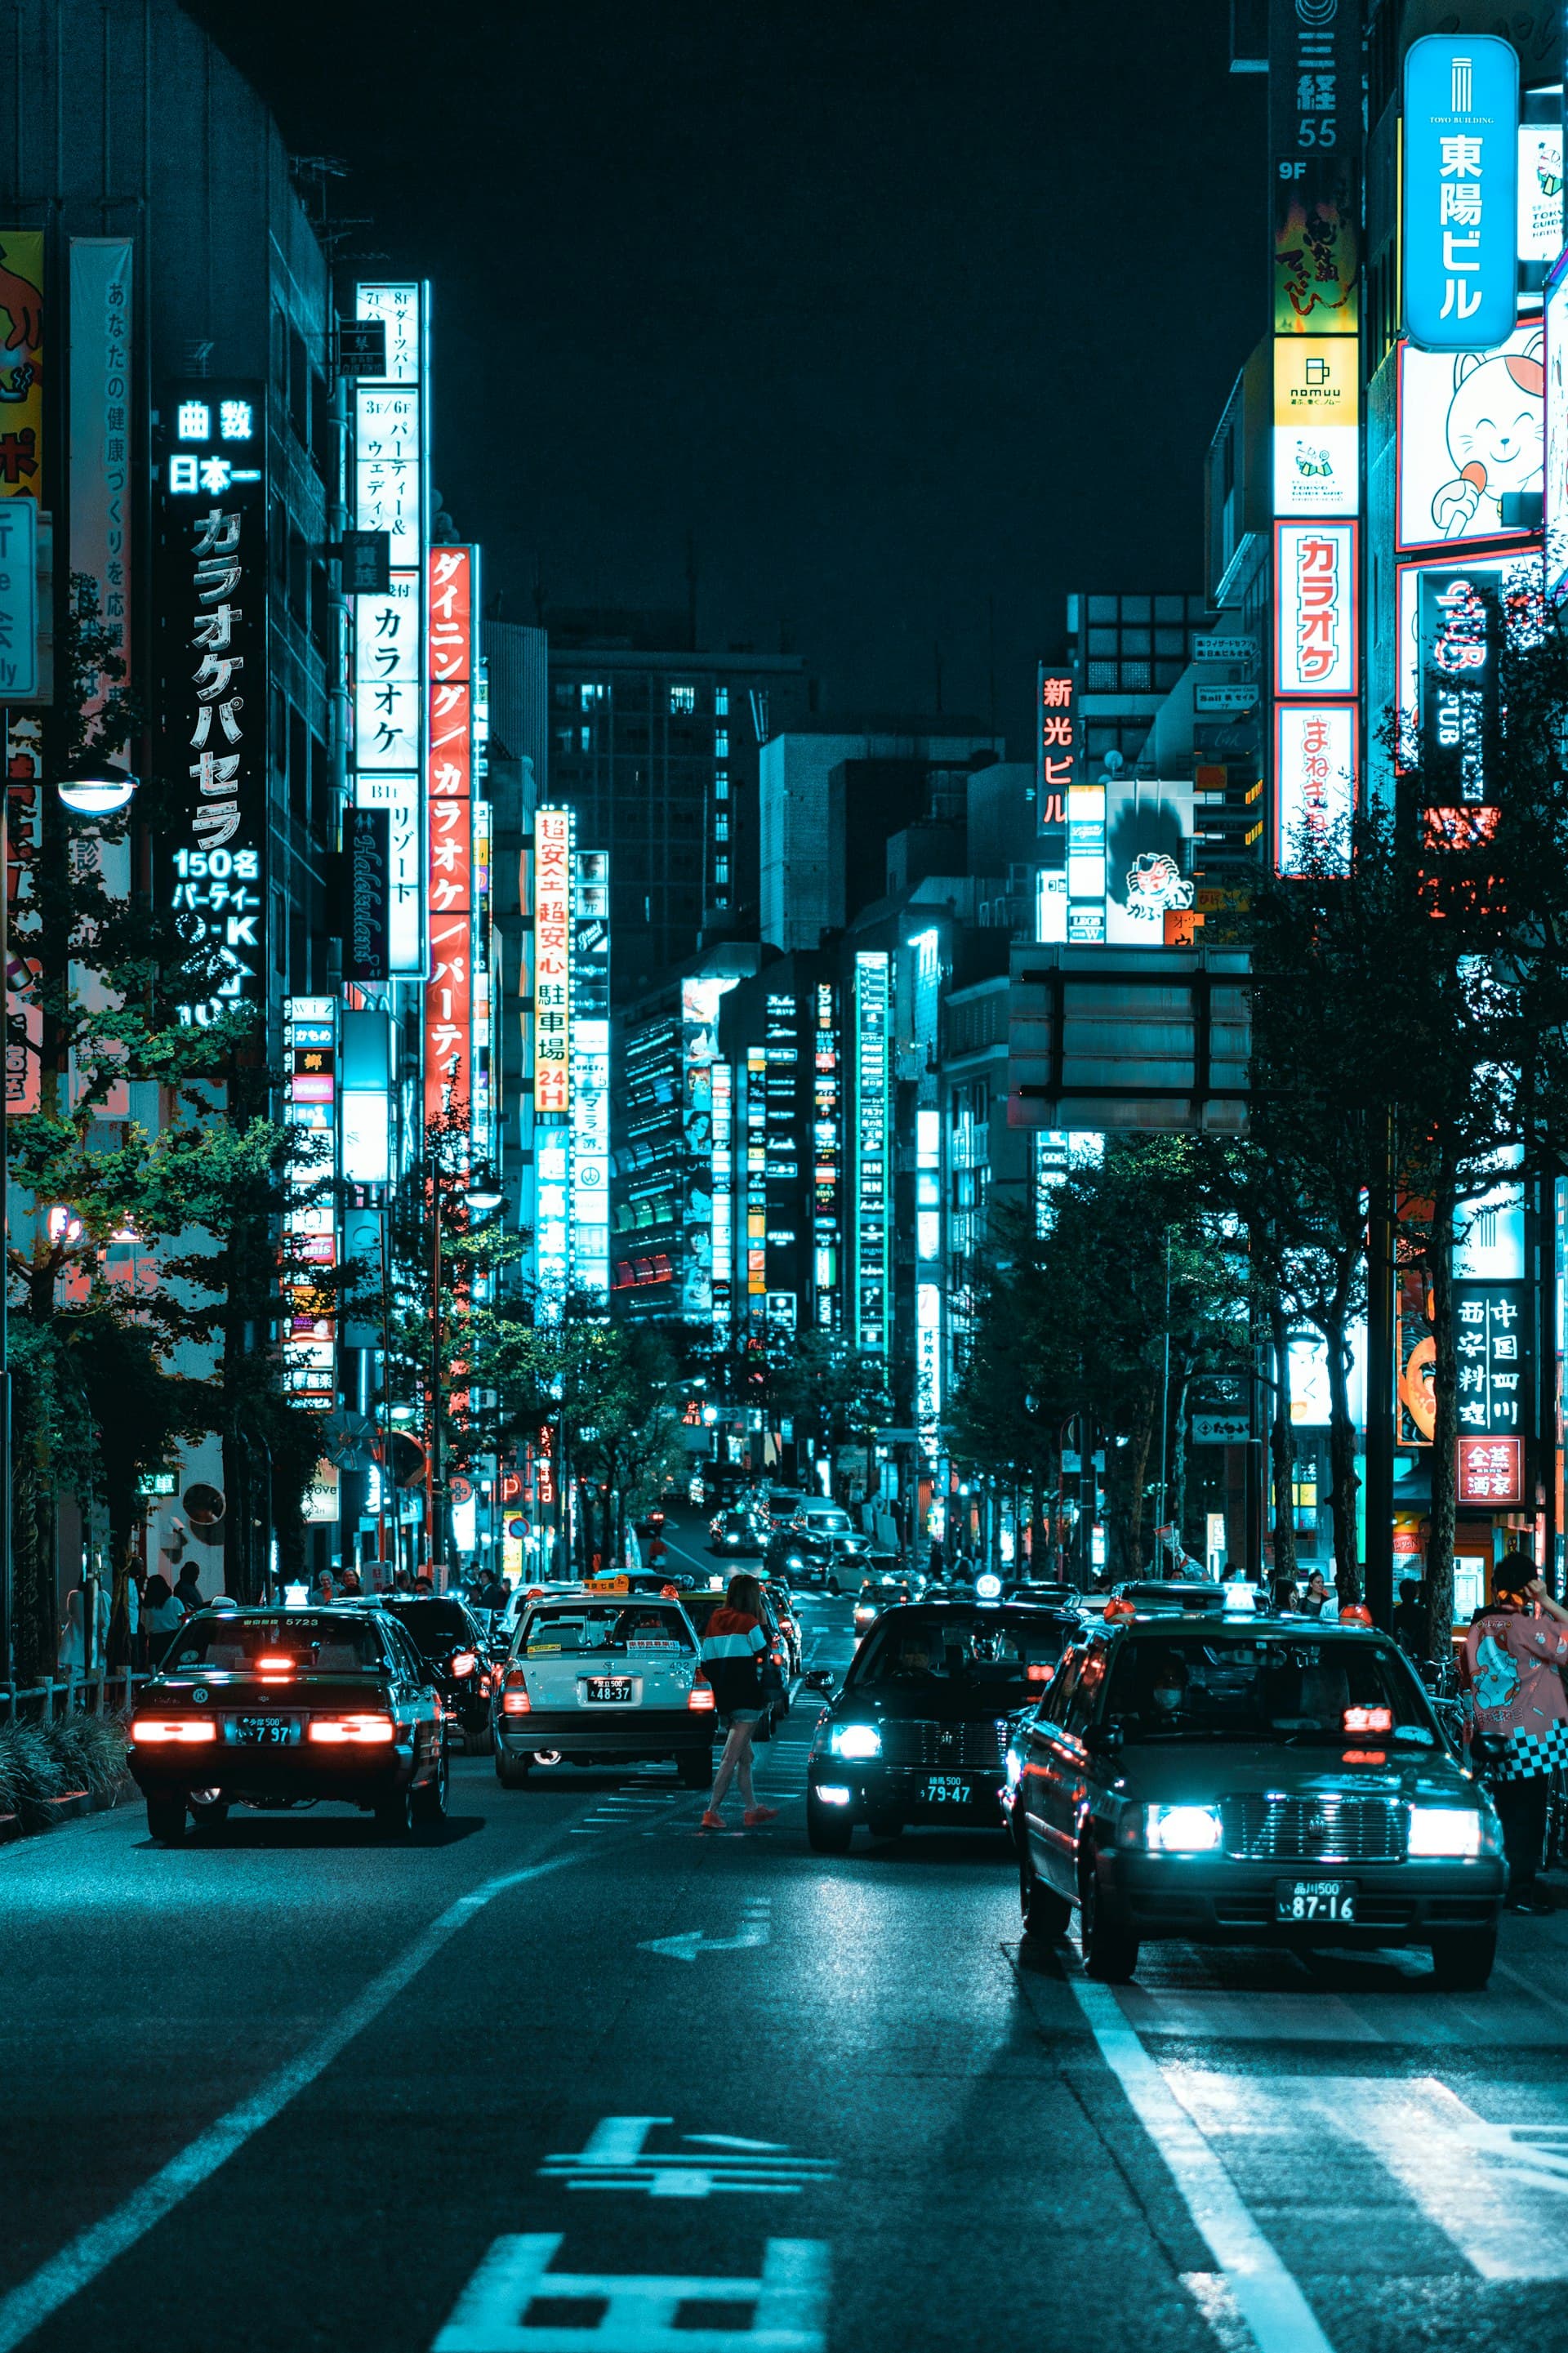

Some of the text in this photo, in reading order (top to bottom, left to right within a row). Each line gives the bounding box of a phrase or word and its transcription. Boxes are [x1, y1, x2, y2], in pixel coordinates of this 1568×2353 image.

[1279, 162, 1307, 180] 9F
[1439, 135, 1483, 319] 東陽ビル
[367, 292, 382, 305] 7F
[394, 292, 410, 305] 8F
[394, 309, 408, 379] ダーツバー
[366, 400, 411, 414] 3F/6F
[1290, 389, 1341, 397] nomuu
[178, 400, 252, 439] 曲数
[170, 455, 261, 494] 日本一
[1302, 540, 1333, 677] カラオケ
[190, 508, 244, 850] カラオケパセラ
[373, 608, 403, 753] カラオケ
[1438, 690, 1460, 745] PUB
[1043, 677, 1073, 823] 新光ビル
[172, 848, 260, 880] 150名
[394, 807, 413, 904] リゾート
[172, 882, 261, 911] パーティー
[538, 818, 566, 1107] 超安全 超安心 駐車場 24H
[862, 1163, 882, 1174] RN
[862, 1182, 882, 1192] RN
[1457, 1302, 1486, 1425] 西安料理
[1490, 1299, 1519, 1424] 中国四川
[1468, 1473, 1511, 1496] 酒家
[286, 1618, 318, 1626] 5723
[597, 1688, 630, 1700] 48-37
[928, 1785, 970, 1803] 79-47
[1294, 1882, 1339, 1896] 品川500
[1292, 1896, 1353, 1919] 87-16
